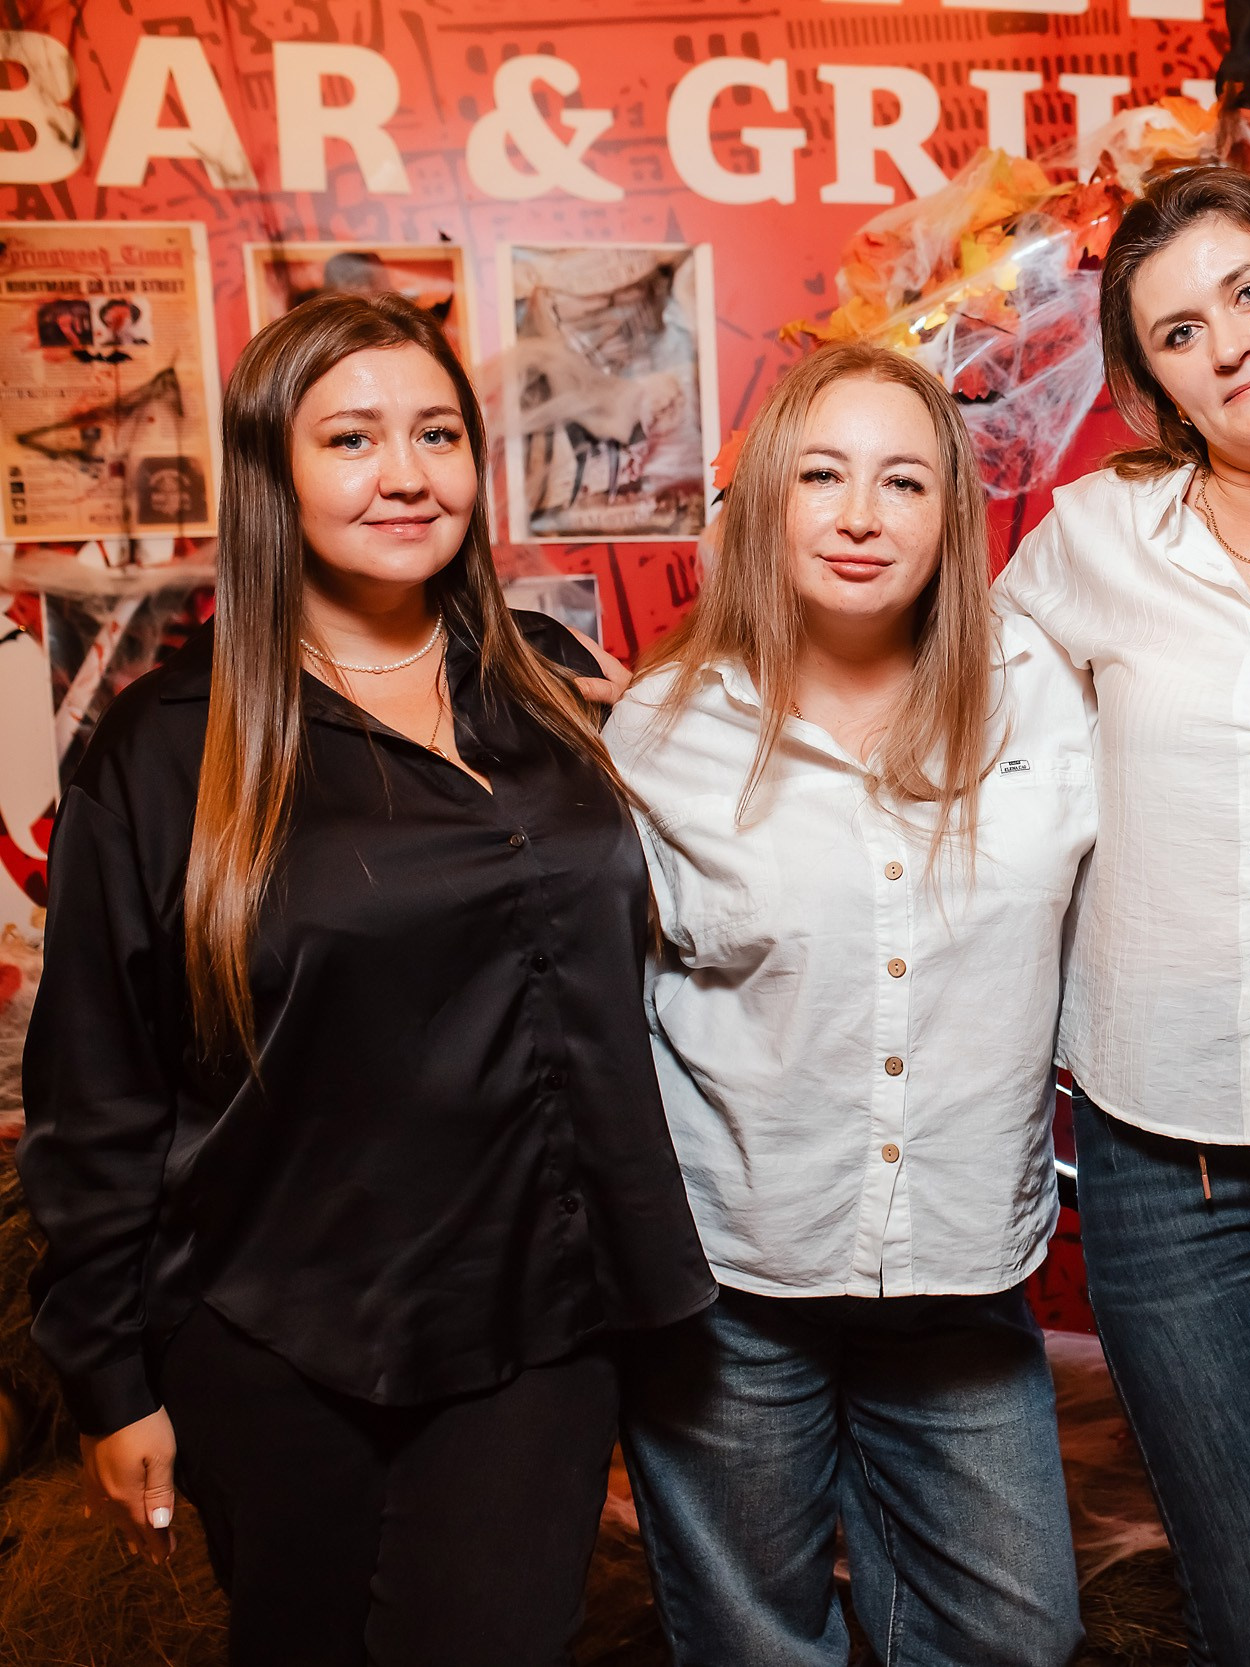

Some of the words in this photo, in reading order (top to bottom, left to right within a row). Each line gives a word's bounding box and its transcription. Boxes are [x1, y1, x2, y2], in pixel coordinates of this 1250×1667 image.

[0, 30, 411, 194] BAR
[466, 54, 625, 201] &
[666, 56, 1218, 205] GRIL
